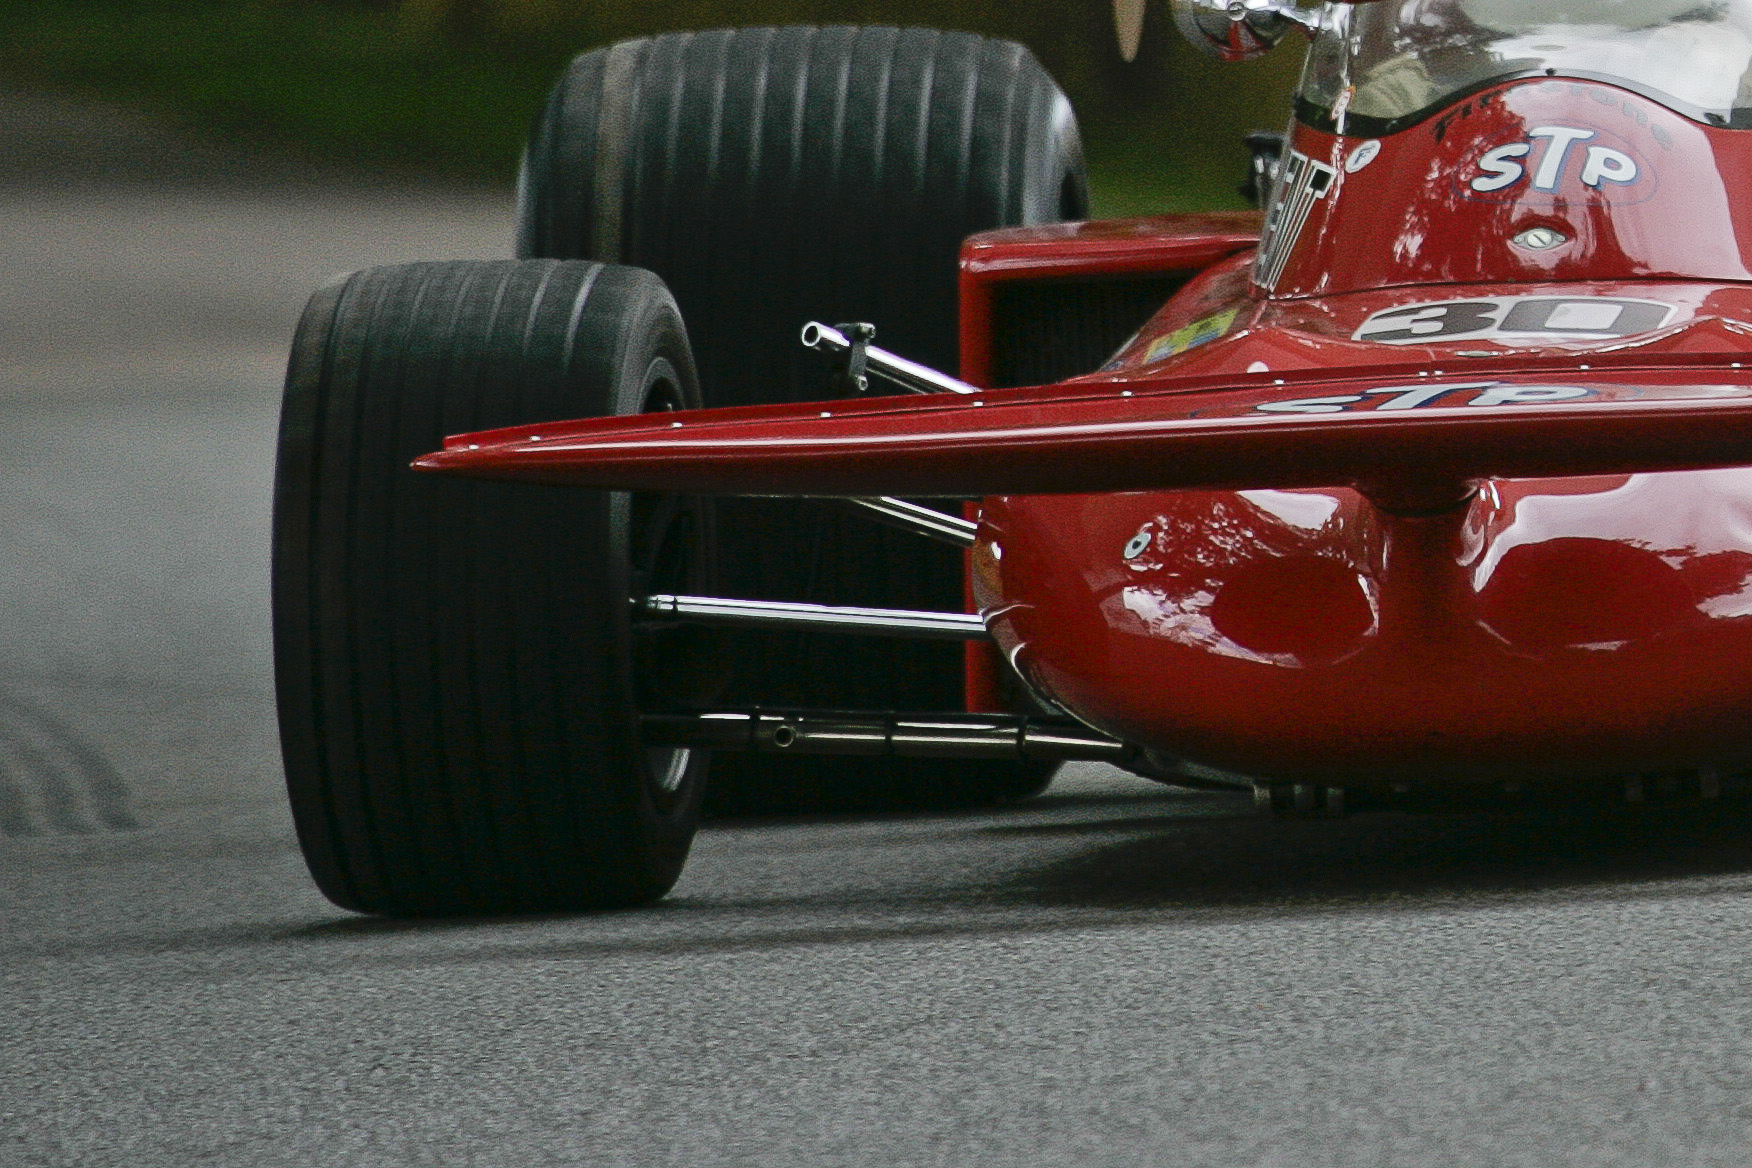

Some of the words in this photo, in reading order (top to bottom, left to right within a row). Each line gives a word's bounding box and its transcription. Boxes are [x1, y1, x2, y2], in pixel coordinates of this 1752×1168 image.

[1433, 82, 1673, 151] Firtone
[1471, 125, 1641, 193] STP
[1354, 297, 1679, 342] 30
[1255, 382, 1592, 414] STP
